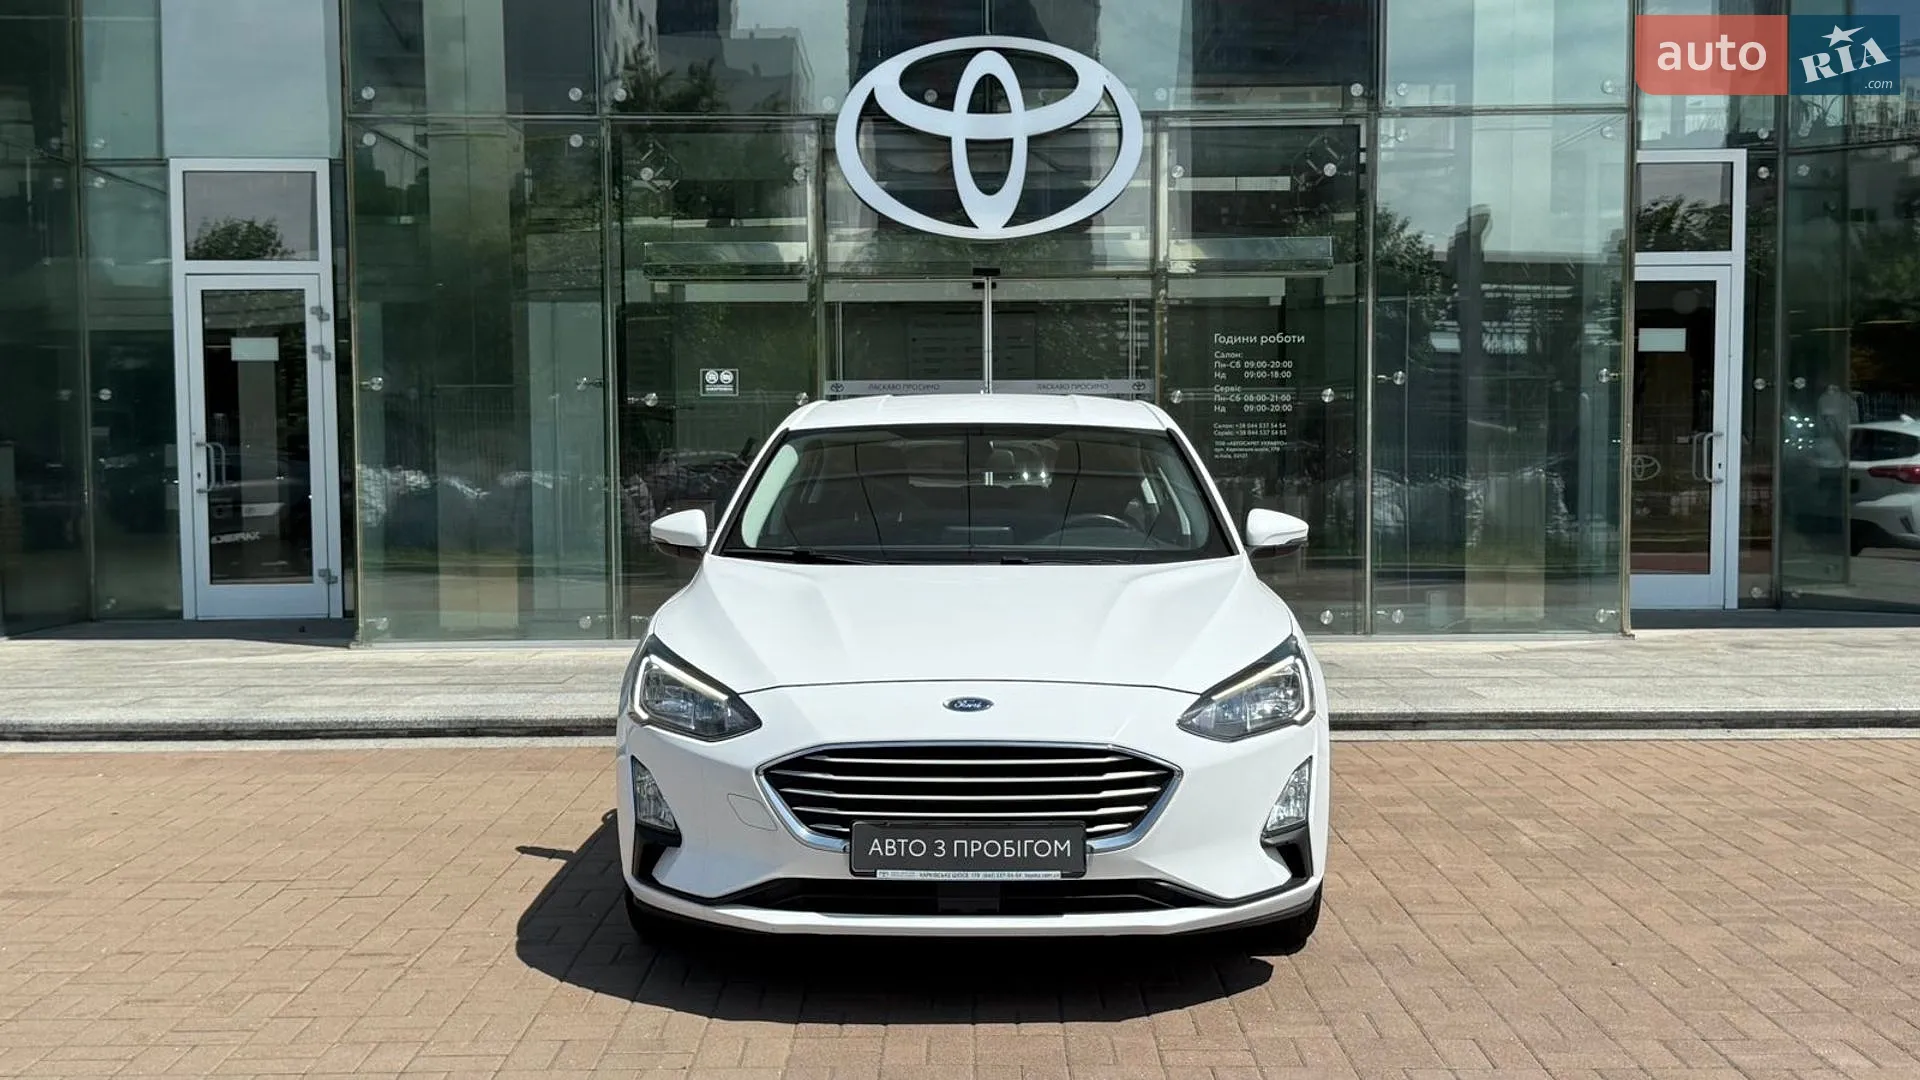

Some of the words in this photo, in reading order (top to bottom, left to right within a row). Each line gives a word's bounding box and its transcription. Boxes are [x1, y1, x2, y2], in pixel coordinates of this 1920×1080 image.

[1214, 333, 1258, 345] Години
[1260, 332, 1305, 346] роботи
[868, 838, 927, 857] АВТО
[953, 839, 1071, 858] ПРОБІГОМ
